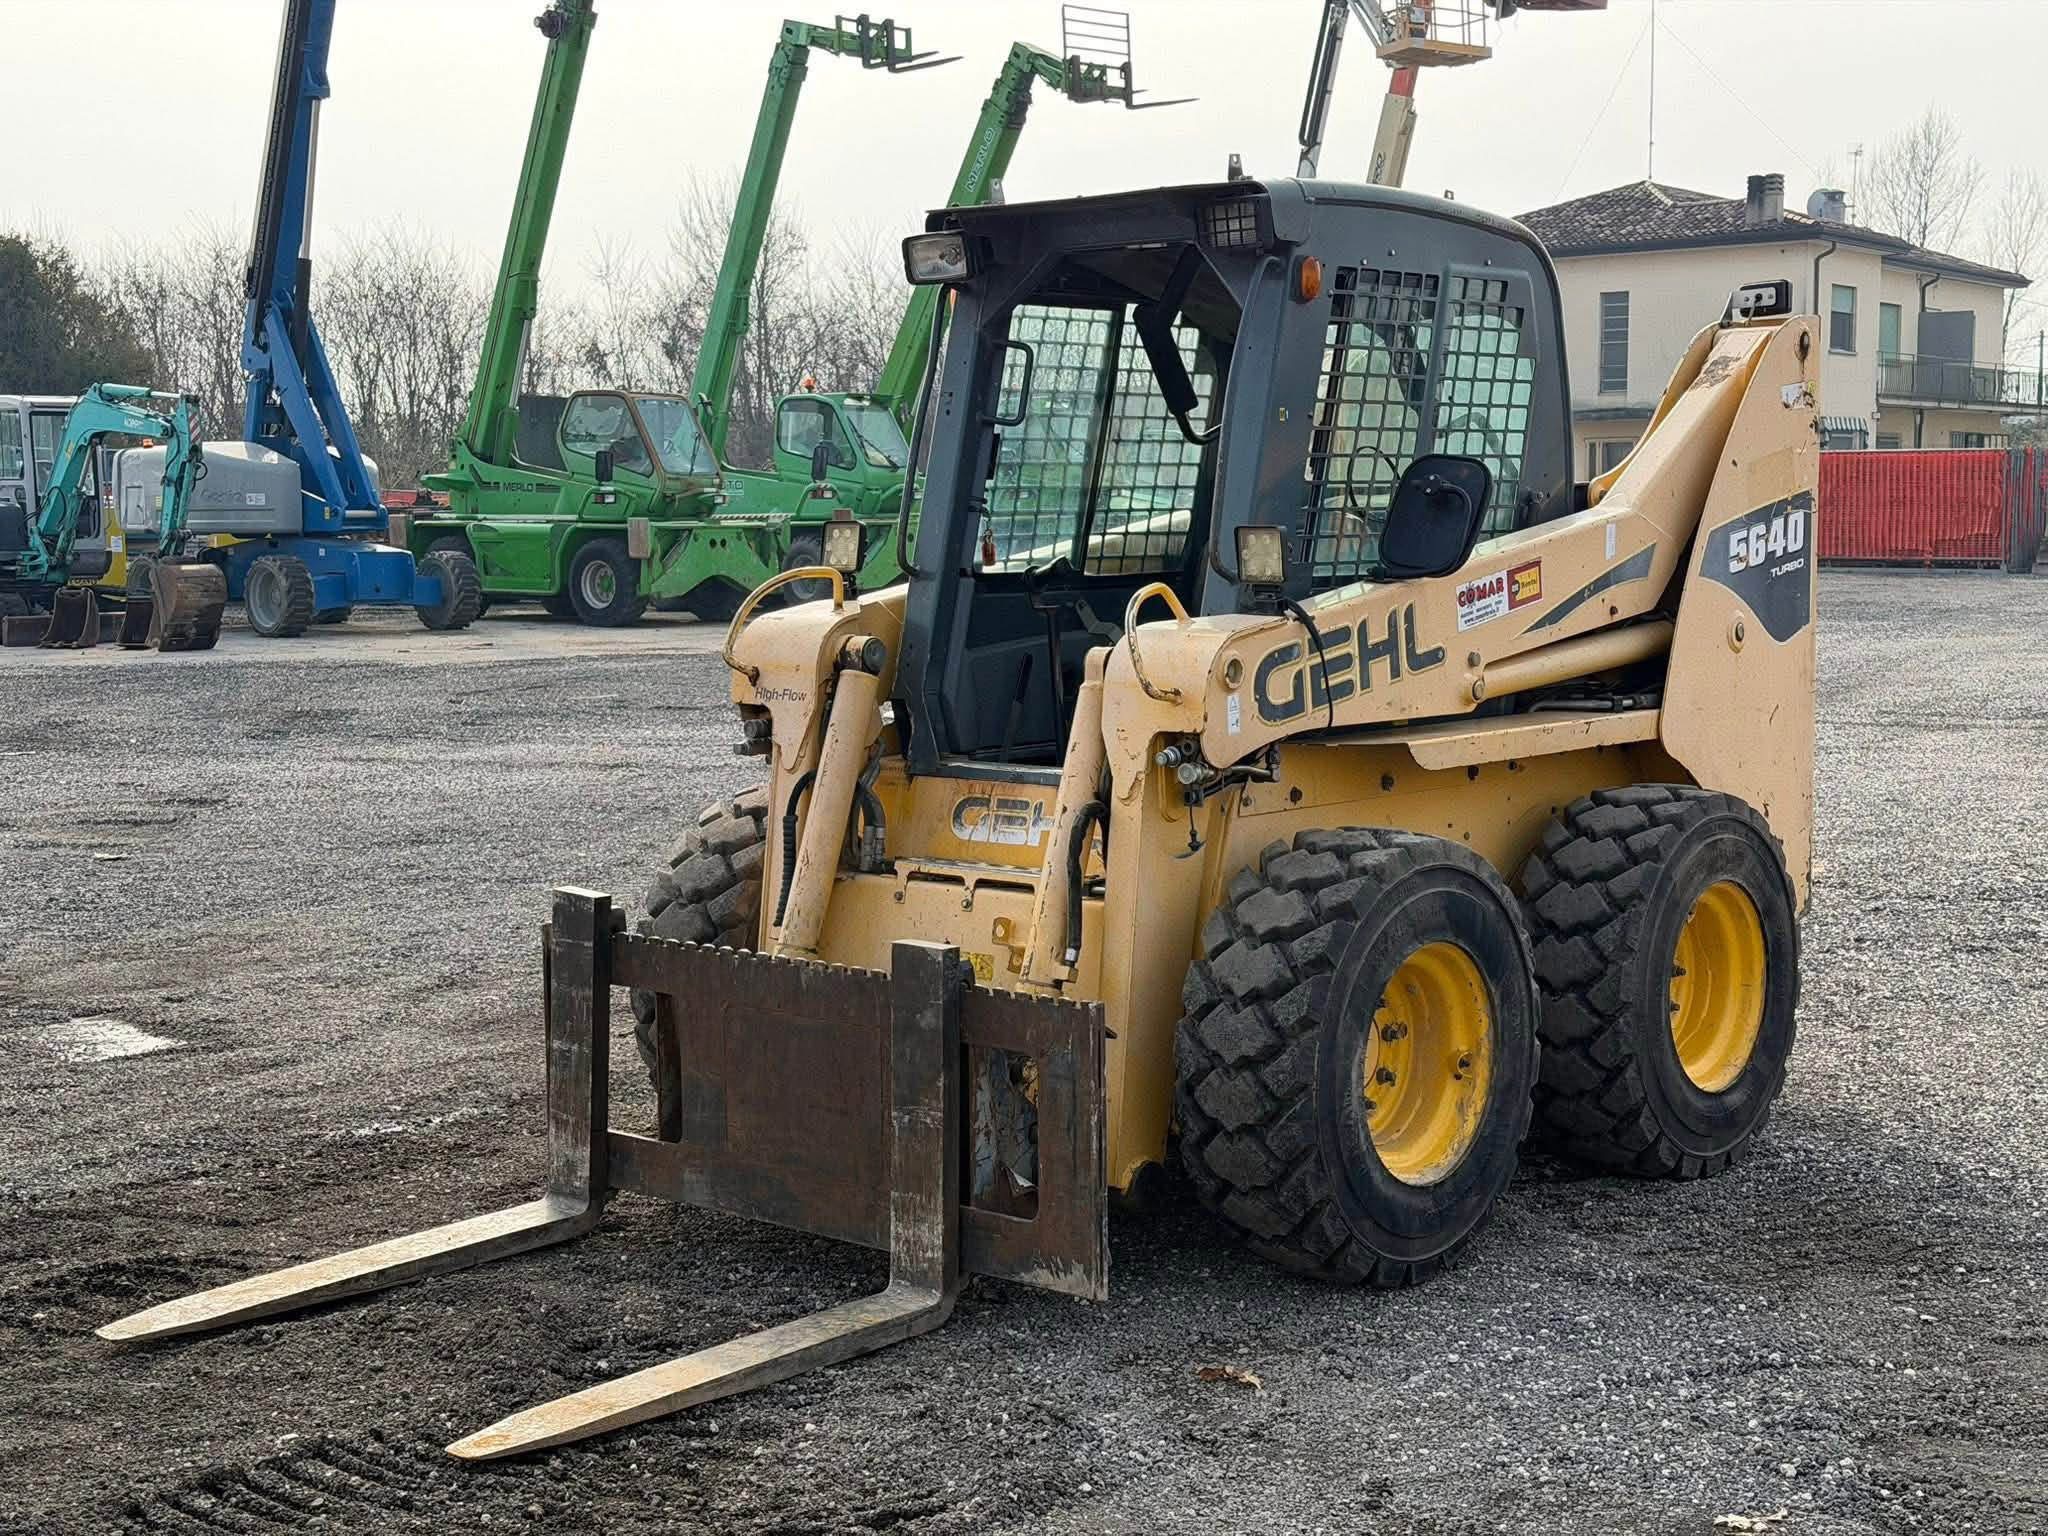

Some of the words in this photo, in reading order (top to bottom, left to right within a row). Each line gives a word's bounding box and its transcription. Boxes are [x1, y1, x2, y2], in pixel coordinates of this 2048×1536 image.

[503, 482, 533, 492] MERLO
[1729, 510, 1804, 574] 5640
[1770, 558, 1804, 577] TURBO
[1458, 577, 1504, 607] COMAR
[1254, 600, 1446, 726] GEHL
[755, 687, 807, 702] High-Flow
[951, 794, 1057, 846] GEH
